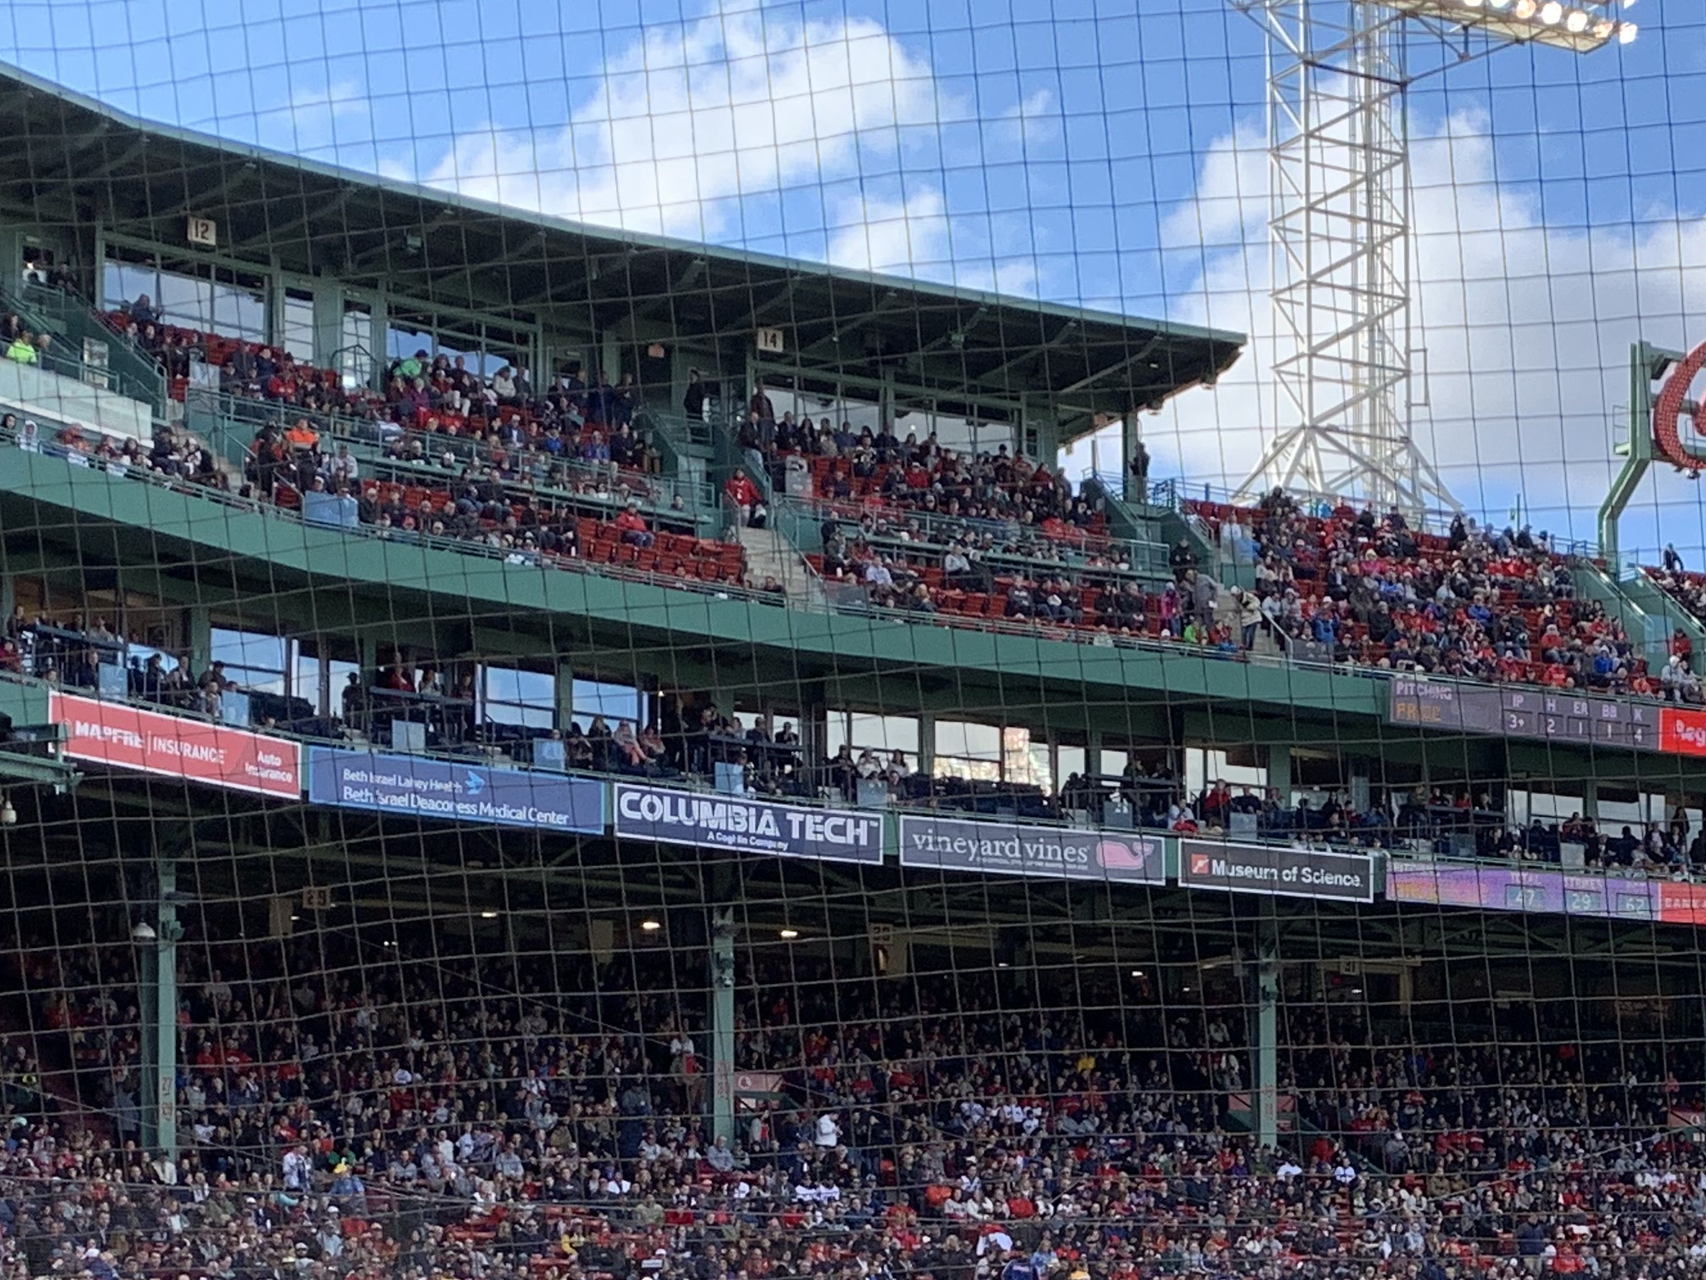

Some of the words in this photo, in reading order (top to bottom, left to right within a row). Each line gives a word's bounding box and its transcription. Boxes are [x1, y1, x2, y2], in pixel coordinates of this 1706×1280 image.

[195, 219, 210, 241] 12
[763, 330, 778, 349] 14
[1396, 681, 1453, 701] PITCHING
[1512, 694, 1524, 708] IP
[1546, 698, 1557, 713] H
[1602, 704, 1618, 719] BB
[1634, 708, 1643, 722] K
[74, 720, 146, 749] MAPFRE
[1547, 718, 1556, 734] 2
[1634, 727, 1643, 743] 4
[153, 736, 227, 765] INSURANCE
[257, 750, 282, 767] Auto
[244, 761, 293, 783] Insurance
[343, 767, 369, 784] Beth
[429, 777, 464, 794] Health
[343, 785, 374, 802] Beth
[479, 801, 527, 821] Medical
[528, 806, 570, 826] Center
[619, 790, 781, 838] COLUMBIA
[786, 811, 869, 846] TECH
[707, 831, 715, 842] A
[911, 828, 1023, 863] vineyard
[1023, 837, 1089, 864] vines
[1211, 858, 1279, 882] Museum
[1281, 866, 1299, 883] of
